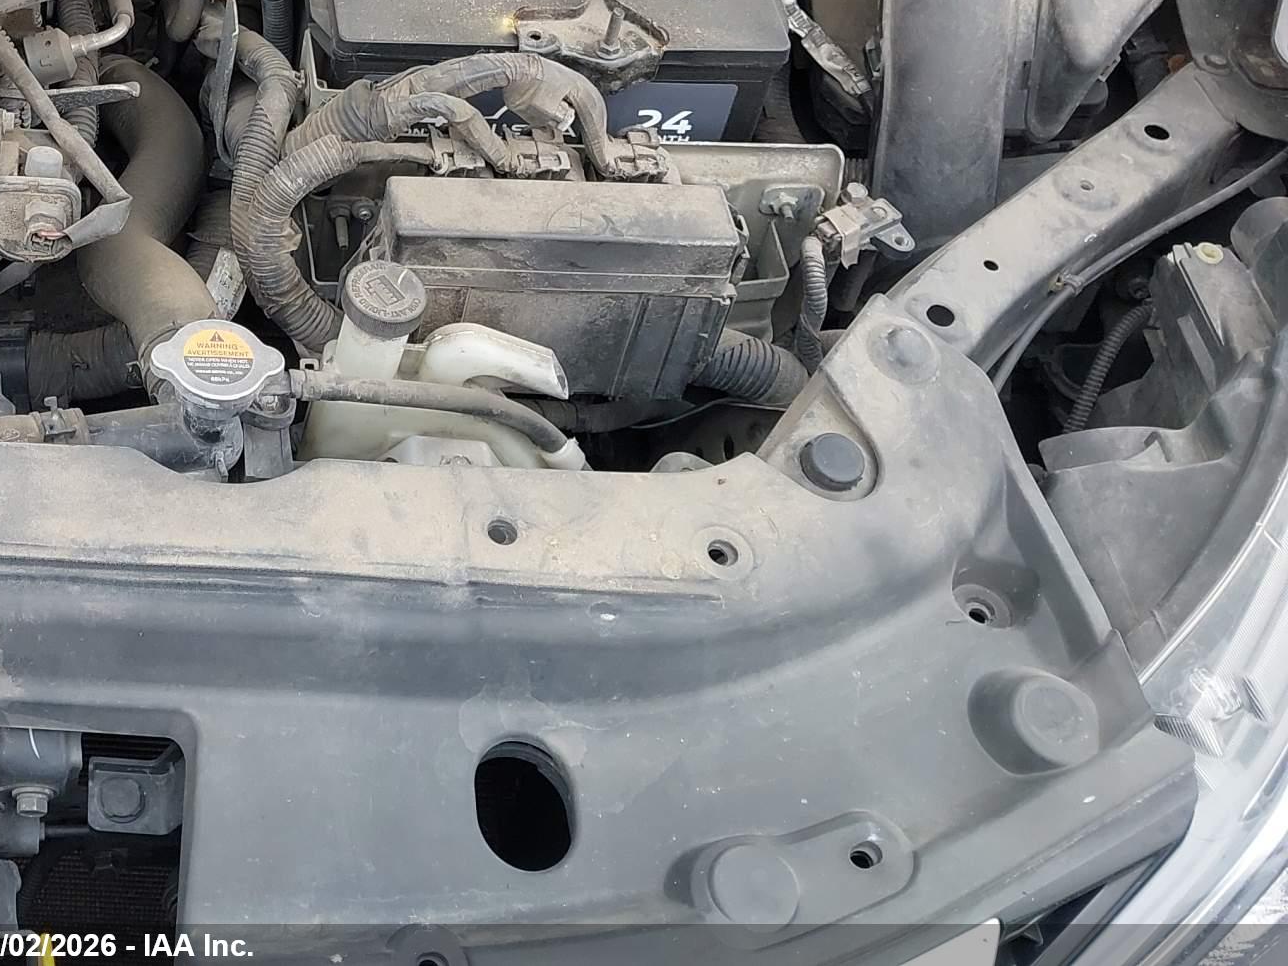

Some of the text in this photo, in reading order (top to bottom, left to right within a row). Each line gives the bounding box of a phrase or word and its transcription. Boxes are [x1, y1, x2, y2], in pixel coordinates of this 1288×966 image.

[637, 110, 693, 134] 24
[196, 342, 239, 351] WARNING
[187, 349, 249, 358] AVERTISSEMENT
